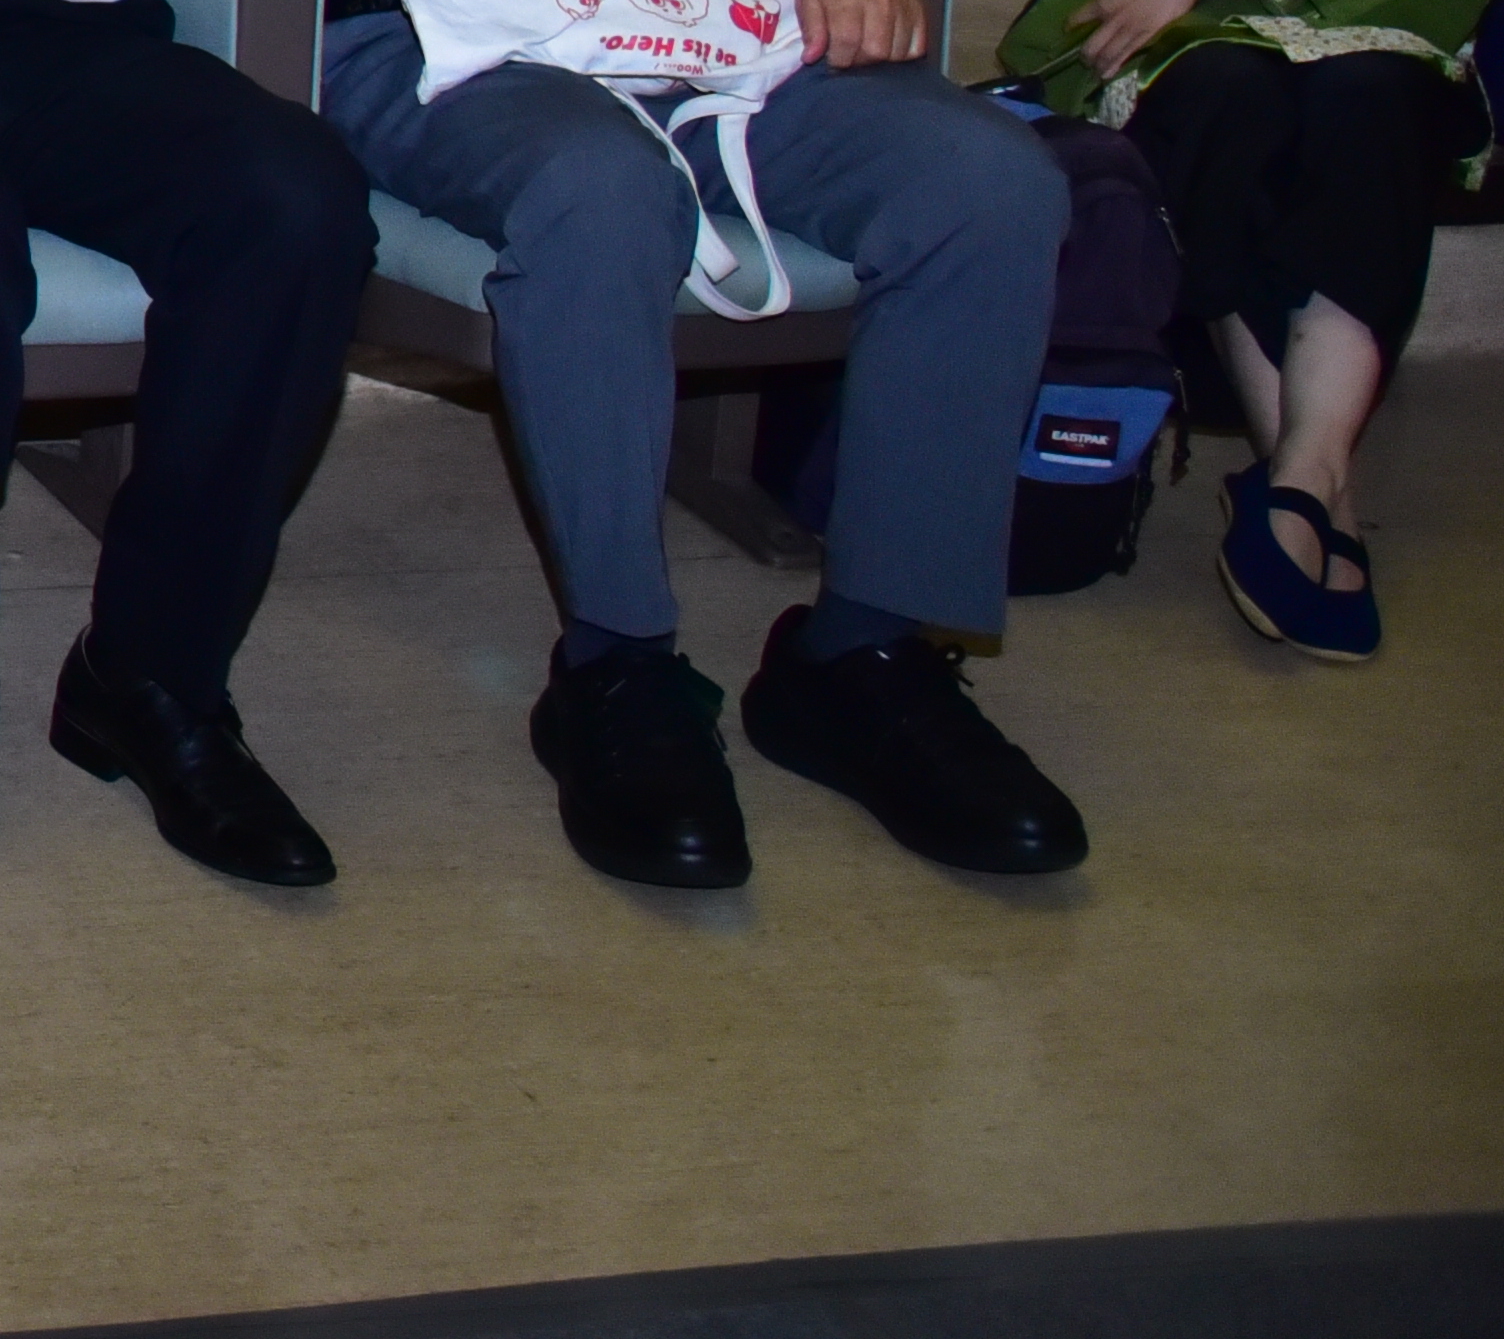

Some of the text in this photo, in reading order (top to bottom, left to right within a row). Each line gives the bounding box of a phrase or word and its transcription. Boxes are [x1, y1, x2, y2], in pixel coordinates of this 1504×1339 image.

[599, 35, 675, 58] Hero.
[681, 39, 712, 64] its
[1051, 430, 1110, 446] EASTPAK
